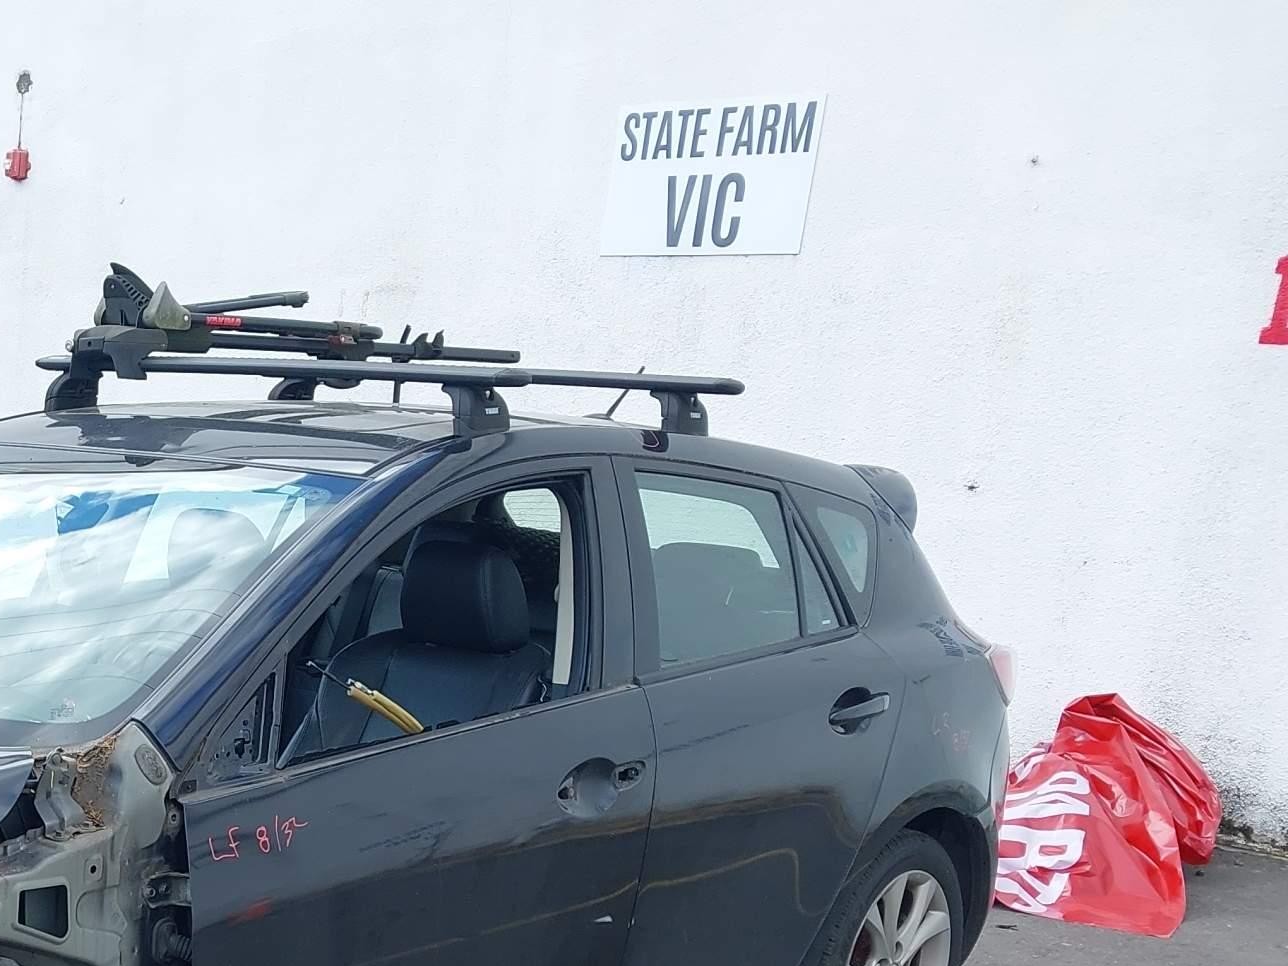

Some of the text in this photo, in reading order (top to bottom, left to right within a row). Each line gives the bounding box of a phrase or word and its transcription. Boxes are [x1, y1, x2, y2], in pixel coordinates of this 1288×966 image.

[620, 100, 818, 161] STATE FARM
[666, 172, 746, 248] VIC
[208, 826, 240, 860] LF
